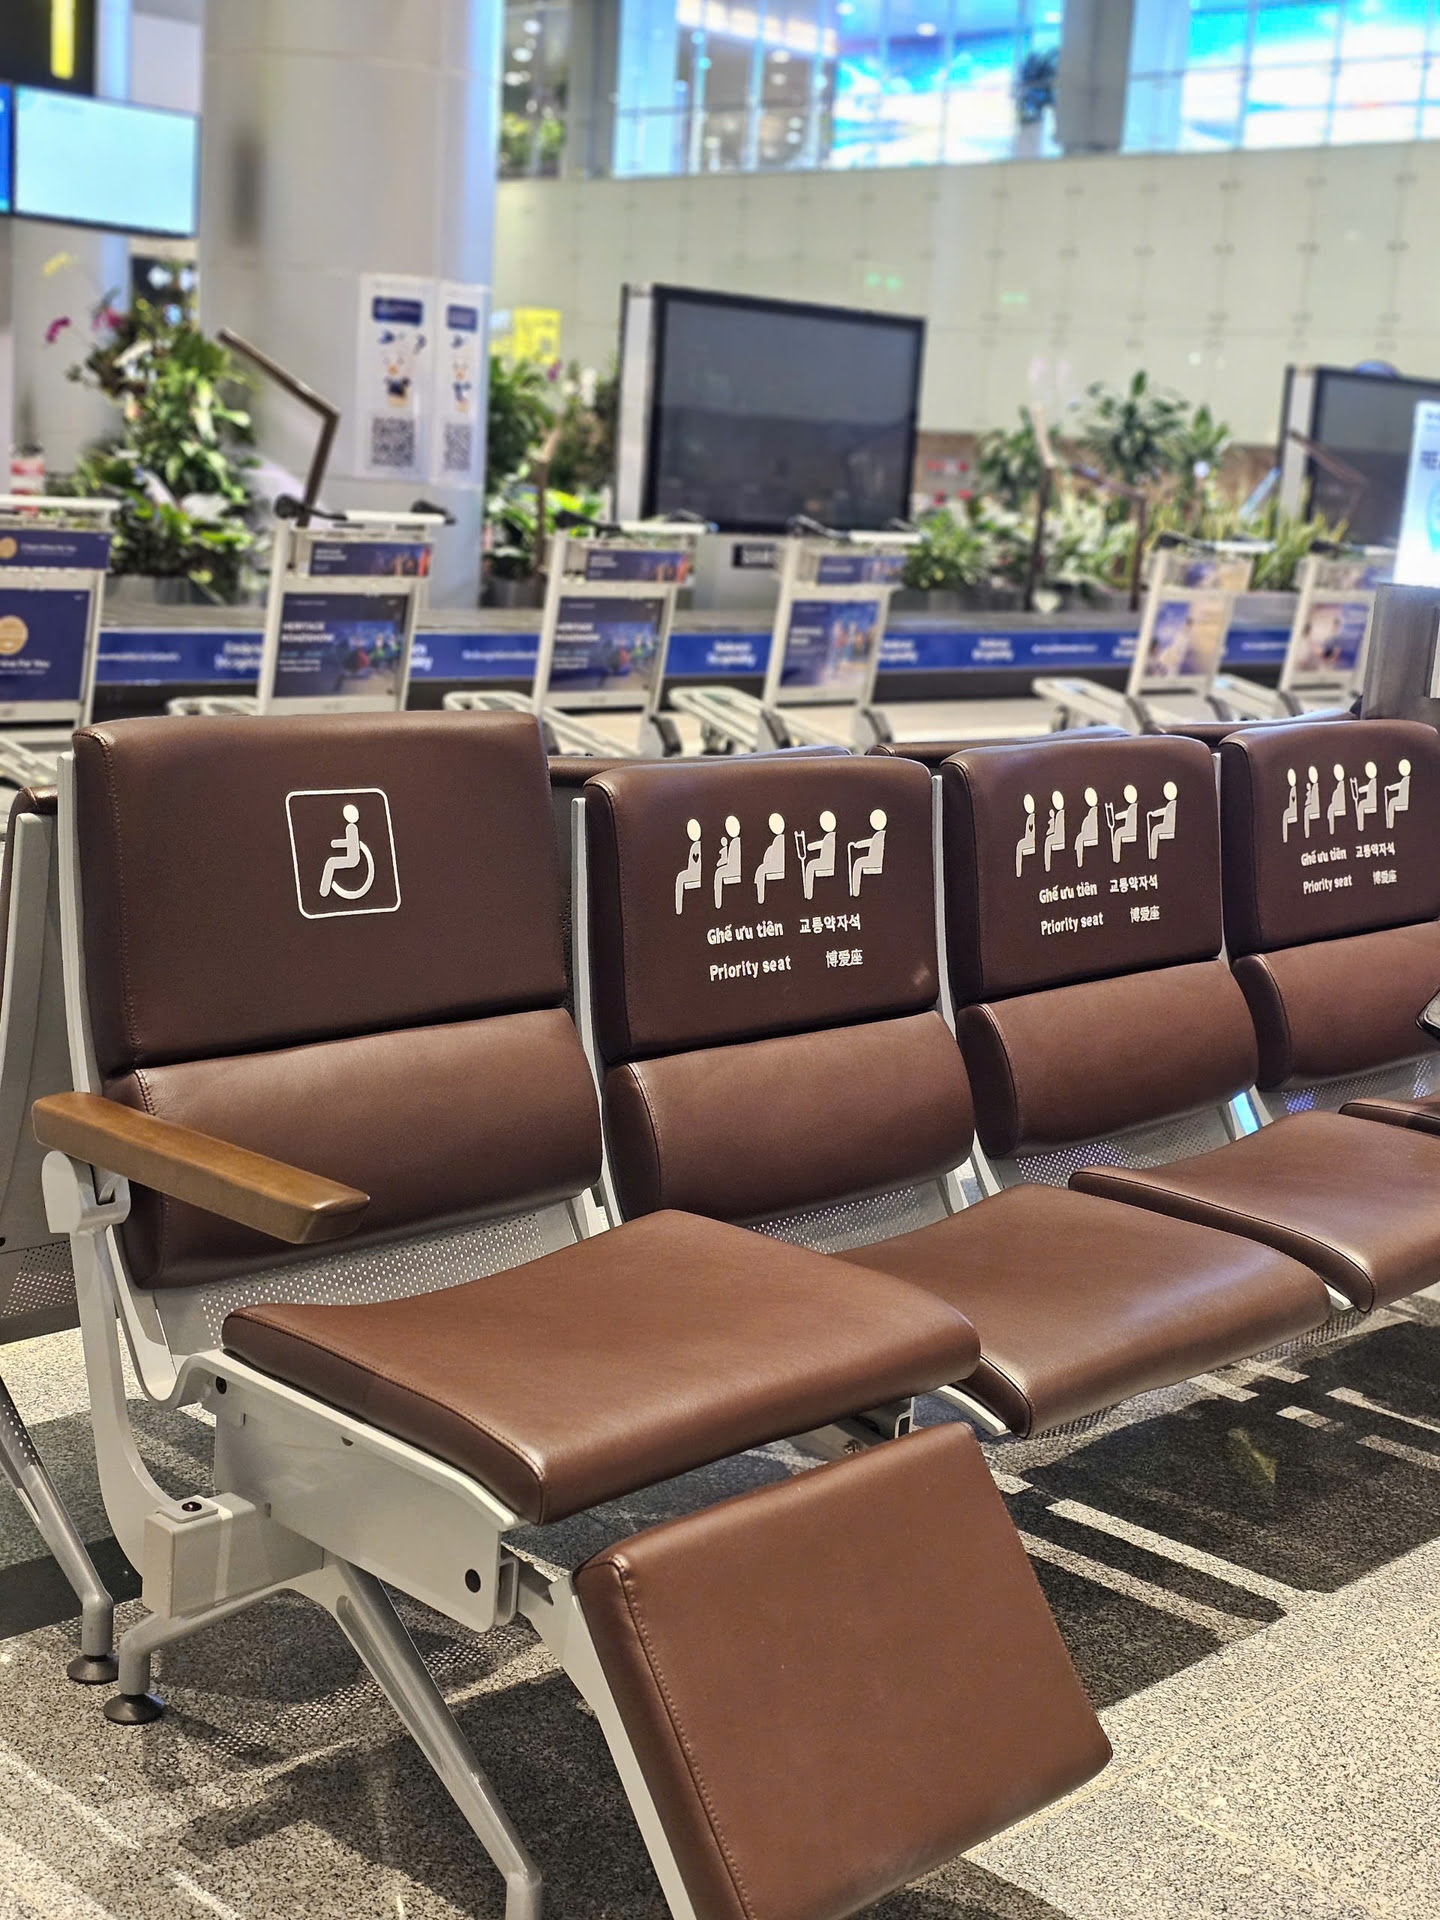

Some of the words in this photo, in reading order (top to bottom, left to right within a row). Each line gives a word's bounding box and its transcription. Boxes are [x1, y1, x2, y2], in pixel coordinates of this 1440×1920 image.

[1300, 849, 1317, 867] Ghế
[1329, 846, 1348, 862] tiên
[1038, 884, 1059, 904] Ghế
[1059, 885, 1075, 900] ưu
[1075, 881, 1098, 898] tiên
[1109, 873, 1159, 893] 교통약자석
[1302, 877, 1333, 895] Priority
[1333, 873, 1353, 889] seat
[799, 912, 861, 934] 교통약자석
[1040, 916, 1079, 936] Priority
[1080, 911, 1104, 928] seat
[1129, 904, 1160, 924] 博爱座
[706, 923, 733, 945] Ghế
[734, 925, 754, 941] ưu
[756, 920, 784, 938] tiên
[709, 960, 759, 982] Priority
[761, 955, 792, 974] seat
[825, 948, 864, 969] 博爱座
